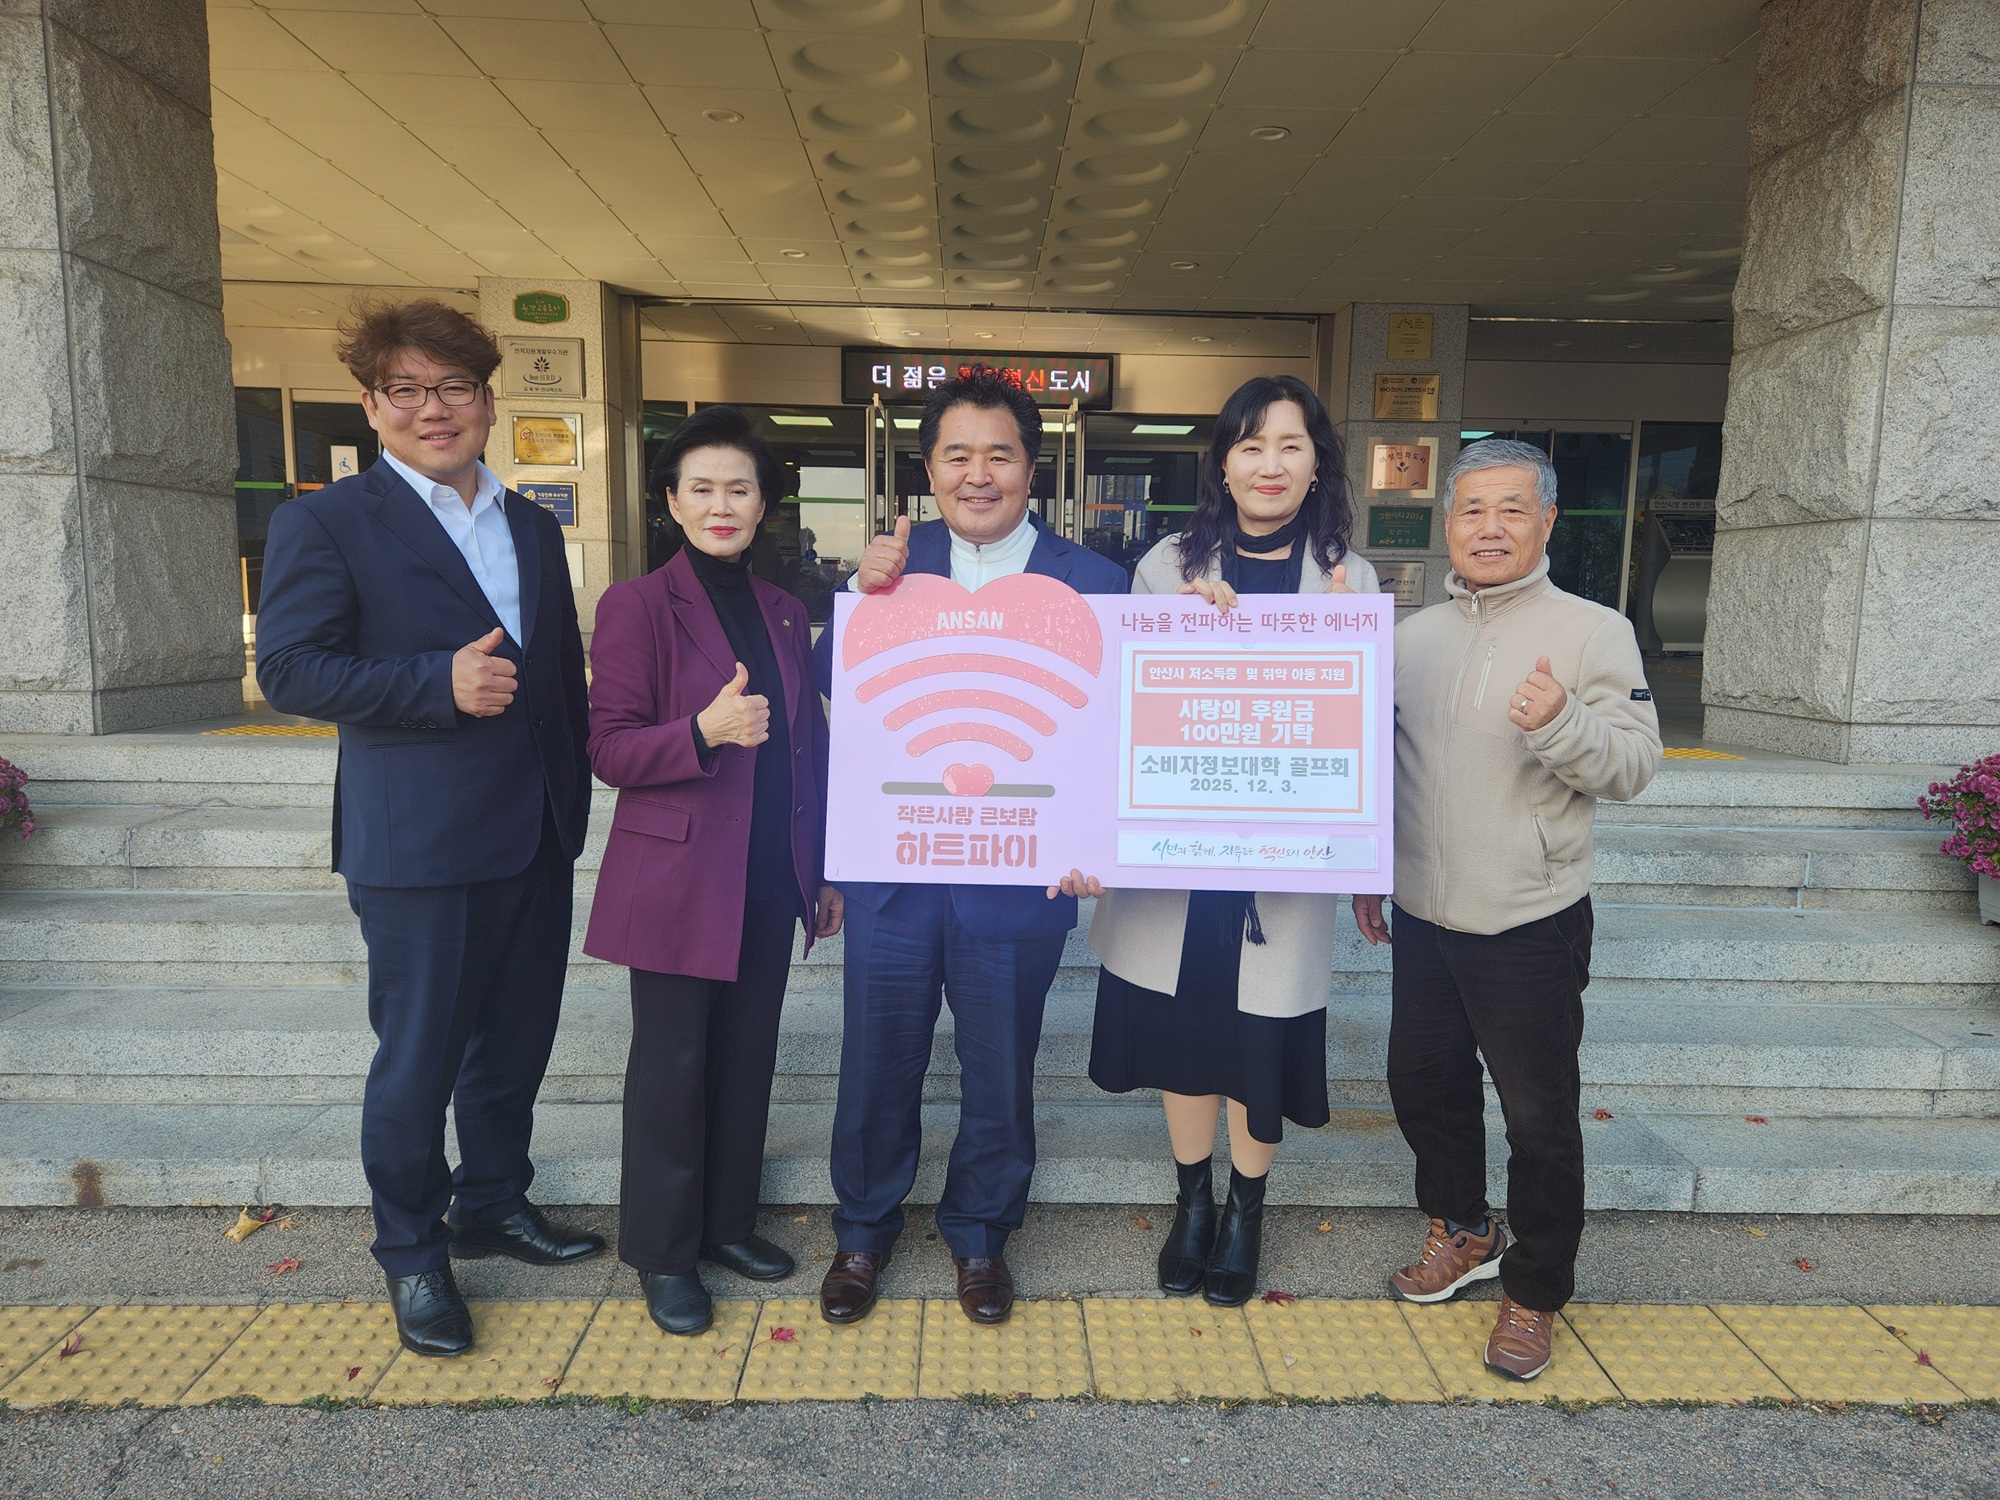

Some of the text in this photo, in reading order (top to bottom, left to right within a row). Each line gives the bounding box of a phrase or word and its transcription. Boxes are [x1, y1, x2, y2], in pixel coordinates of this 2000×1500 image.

[871, 364, 892, 388] 더
[902, 365, 947, 390] 젊은
[1379, 451, 1427, 465] 여성친화도시
[936, 609, 1005, 631] ANSAN
[1121, 612, 1379, 634] 나눔을 전파하는 따뜻한 에너지
[1149, 667, 1345, 682] 안산시 저소득층 및 취약 아동 지원
[1179, 699, 1315, 723] 사랑의 후원금
[1180, 723, 1314, 746] 100만원 기탁
[1140, 755, 1349, 778] 소비자정보대학 골프회
[1190, 778, 1298, 795] 2025. 12. 3.
[897, 805, 1038, 827] 작은사랑 큰보람
[896, 831, 1038, 869] 하트파이
[1151, 838, 1188, 861] 시민과
[1258, 844, 1300, 863] 혁신도시
[1303, 844, 1337, 860] 안산
